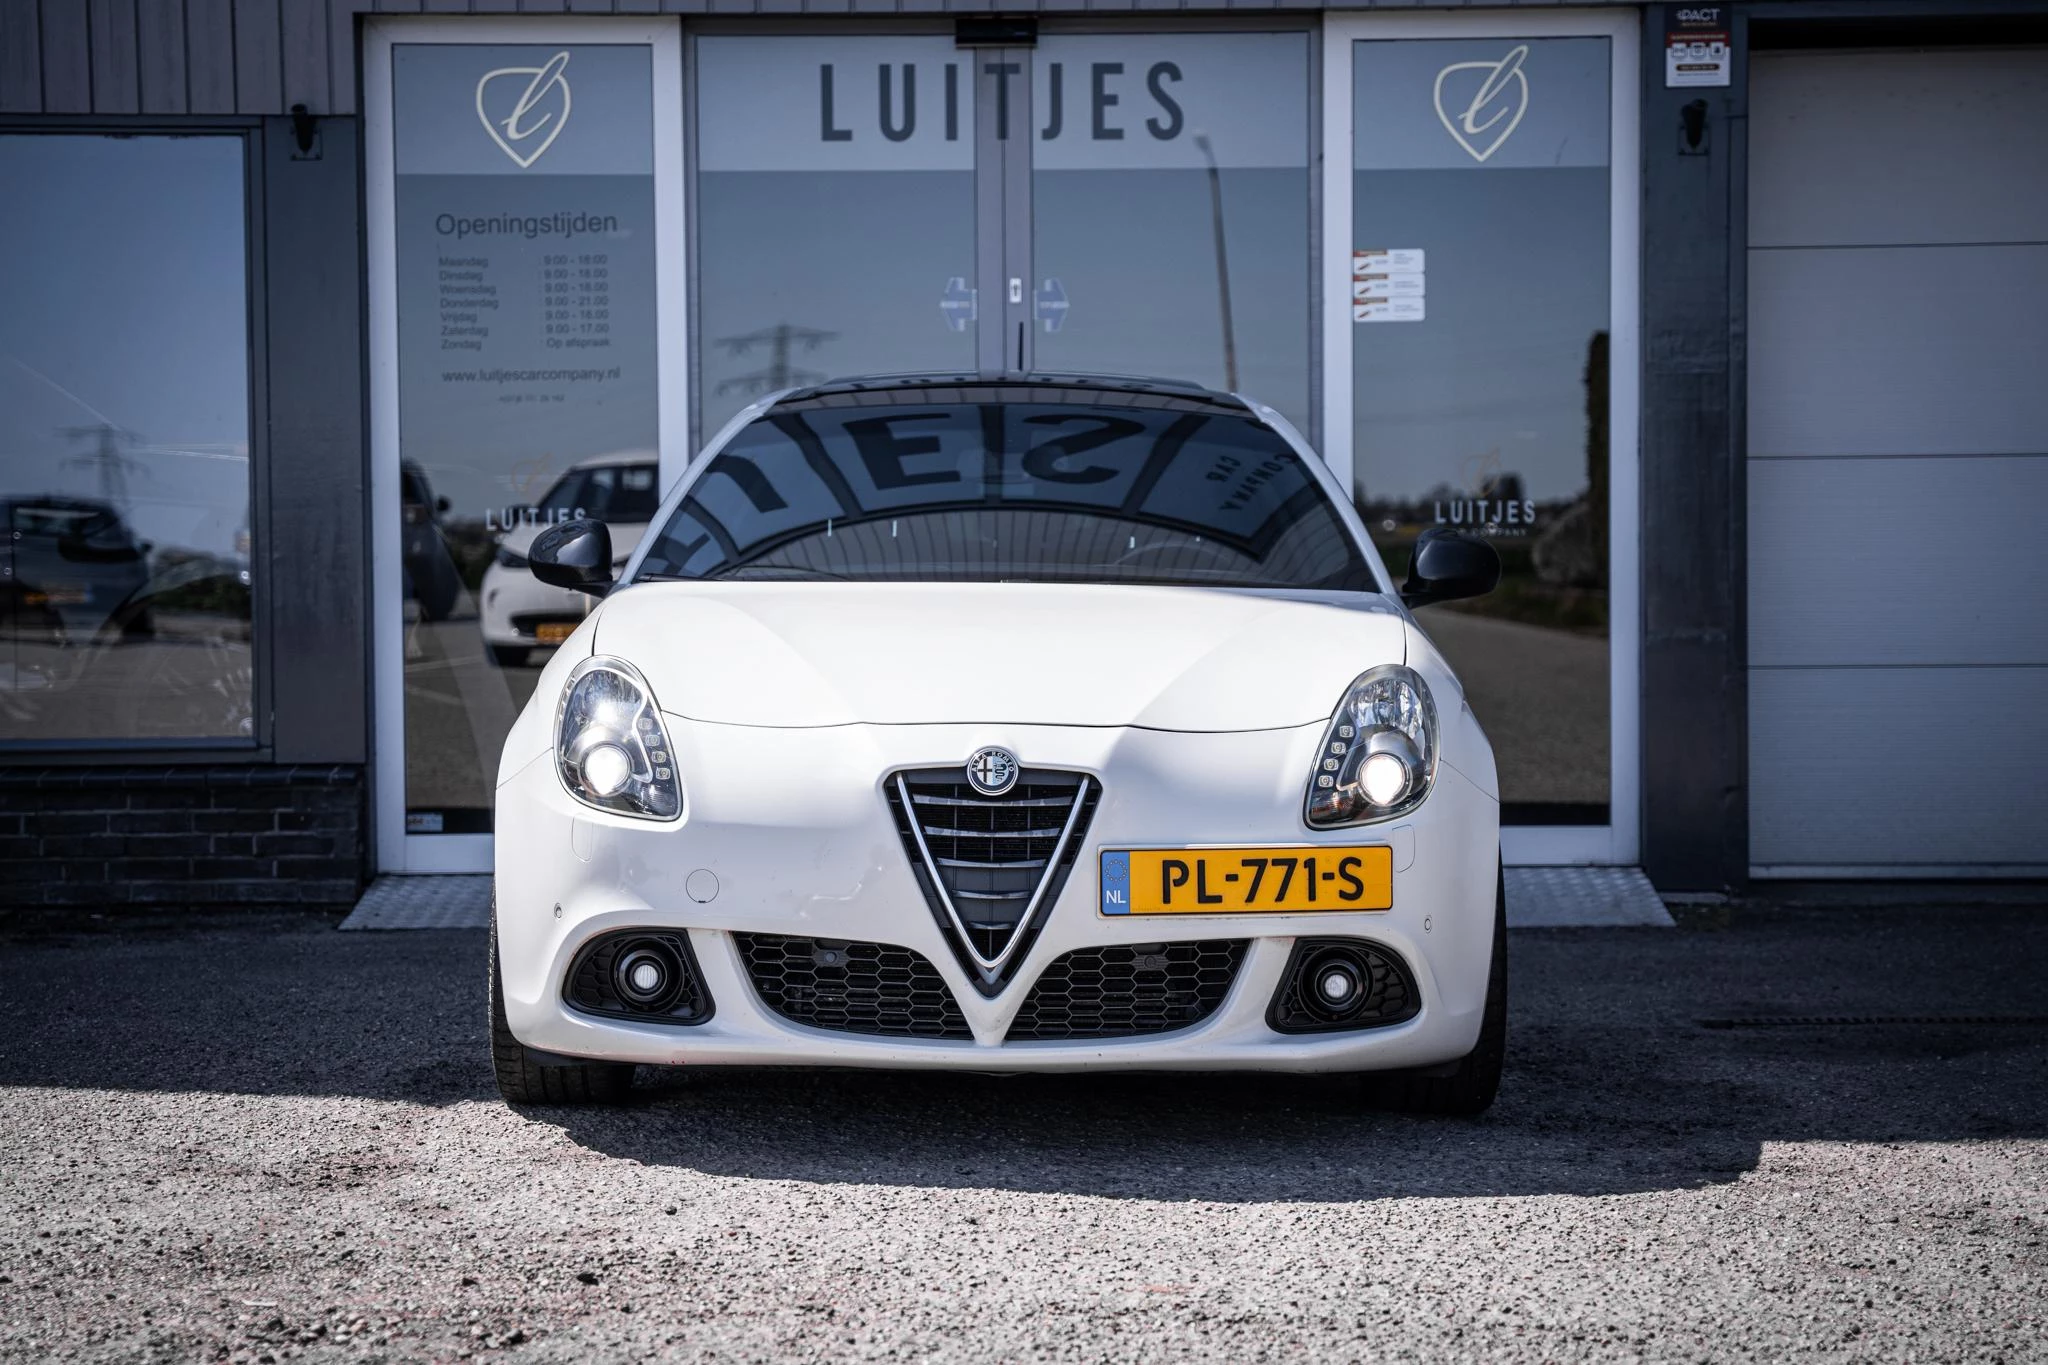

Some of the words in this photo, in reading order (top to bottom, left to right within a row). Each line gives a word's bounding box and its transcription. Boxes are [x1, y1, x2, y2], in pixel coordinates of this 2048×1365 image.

[821, 61, 1183, 142] LUITJES
[435, 211, 618, 239] Openingstijden
[438, 256, 489, 268] Maandag
[439, 270, 483, 282] Dinsdag
[439, 284, 496, 296] Woensdag
[440, 297, 499, 310] Donderdag
[440, 312, 477, 323] Vrijdag
[441, 325, 488, 337] Zaterdag
[441, 339, 482, 351] Zondag
[546, 337, 563, 349] Op
[566, 337, 610, 349] afspraak
[441, 366, 621, 383] www.luitjescarcompany.nl
[1434, 500, 1536, 524] LUITJES
[971, 753, 987, 772] ALFA
[992, 751, 1014, 772] ROMEO
[1105, 889, 1127, 905] NL
[1162, 856, 1365, 905] PL-771-S
